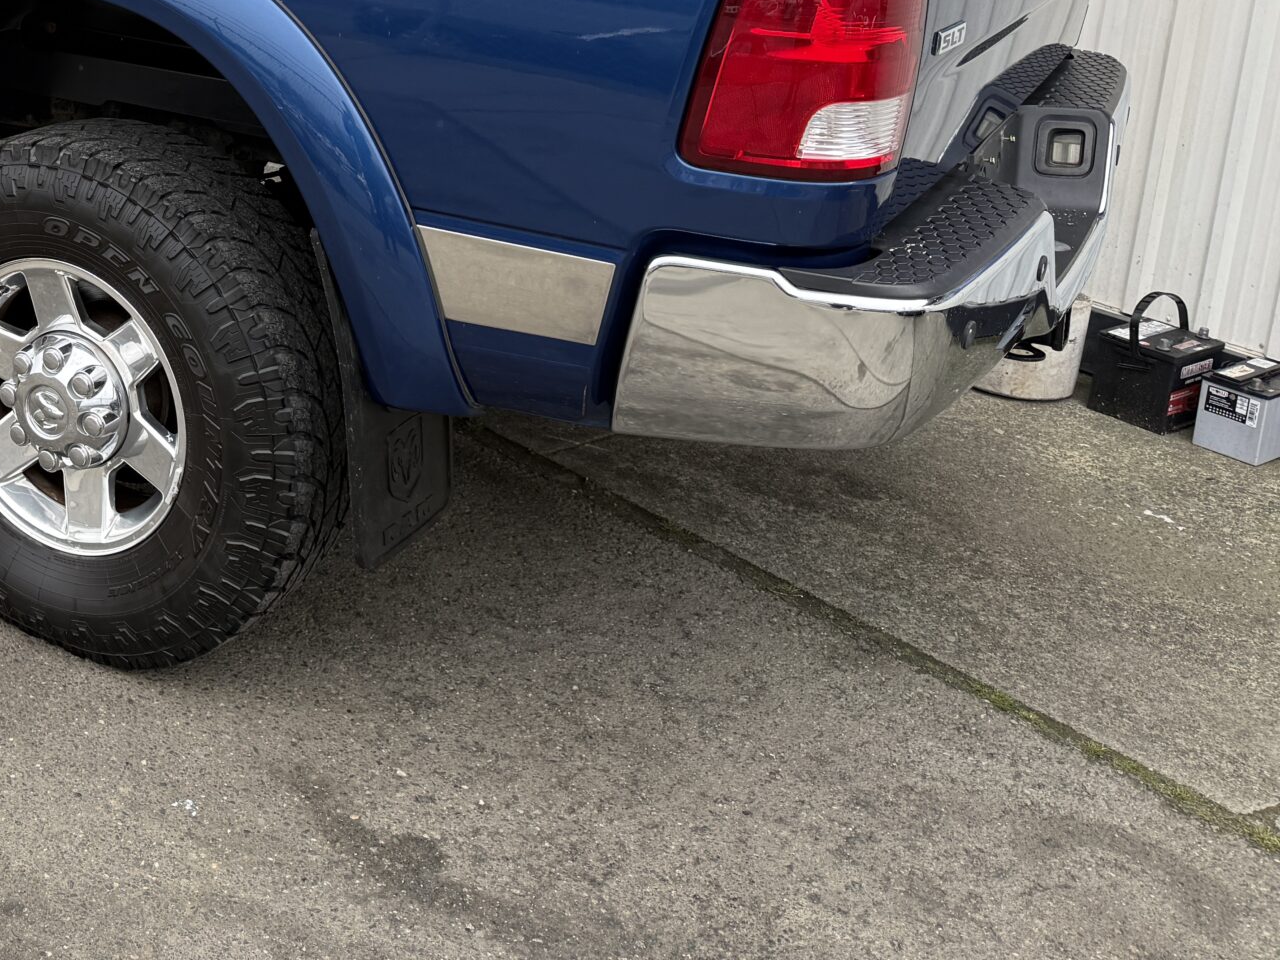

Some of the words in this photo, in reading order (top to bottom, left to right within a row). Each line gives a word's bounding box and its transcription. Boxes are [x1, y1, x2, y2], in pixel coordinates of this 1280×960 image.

[941, 26, 965, 50] SLT
[41, 215, 160, 295] OPEN
[163, 311, 224, 558] COUNTRY
